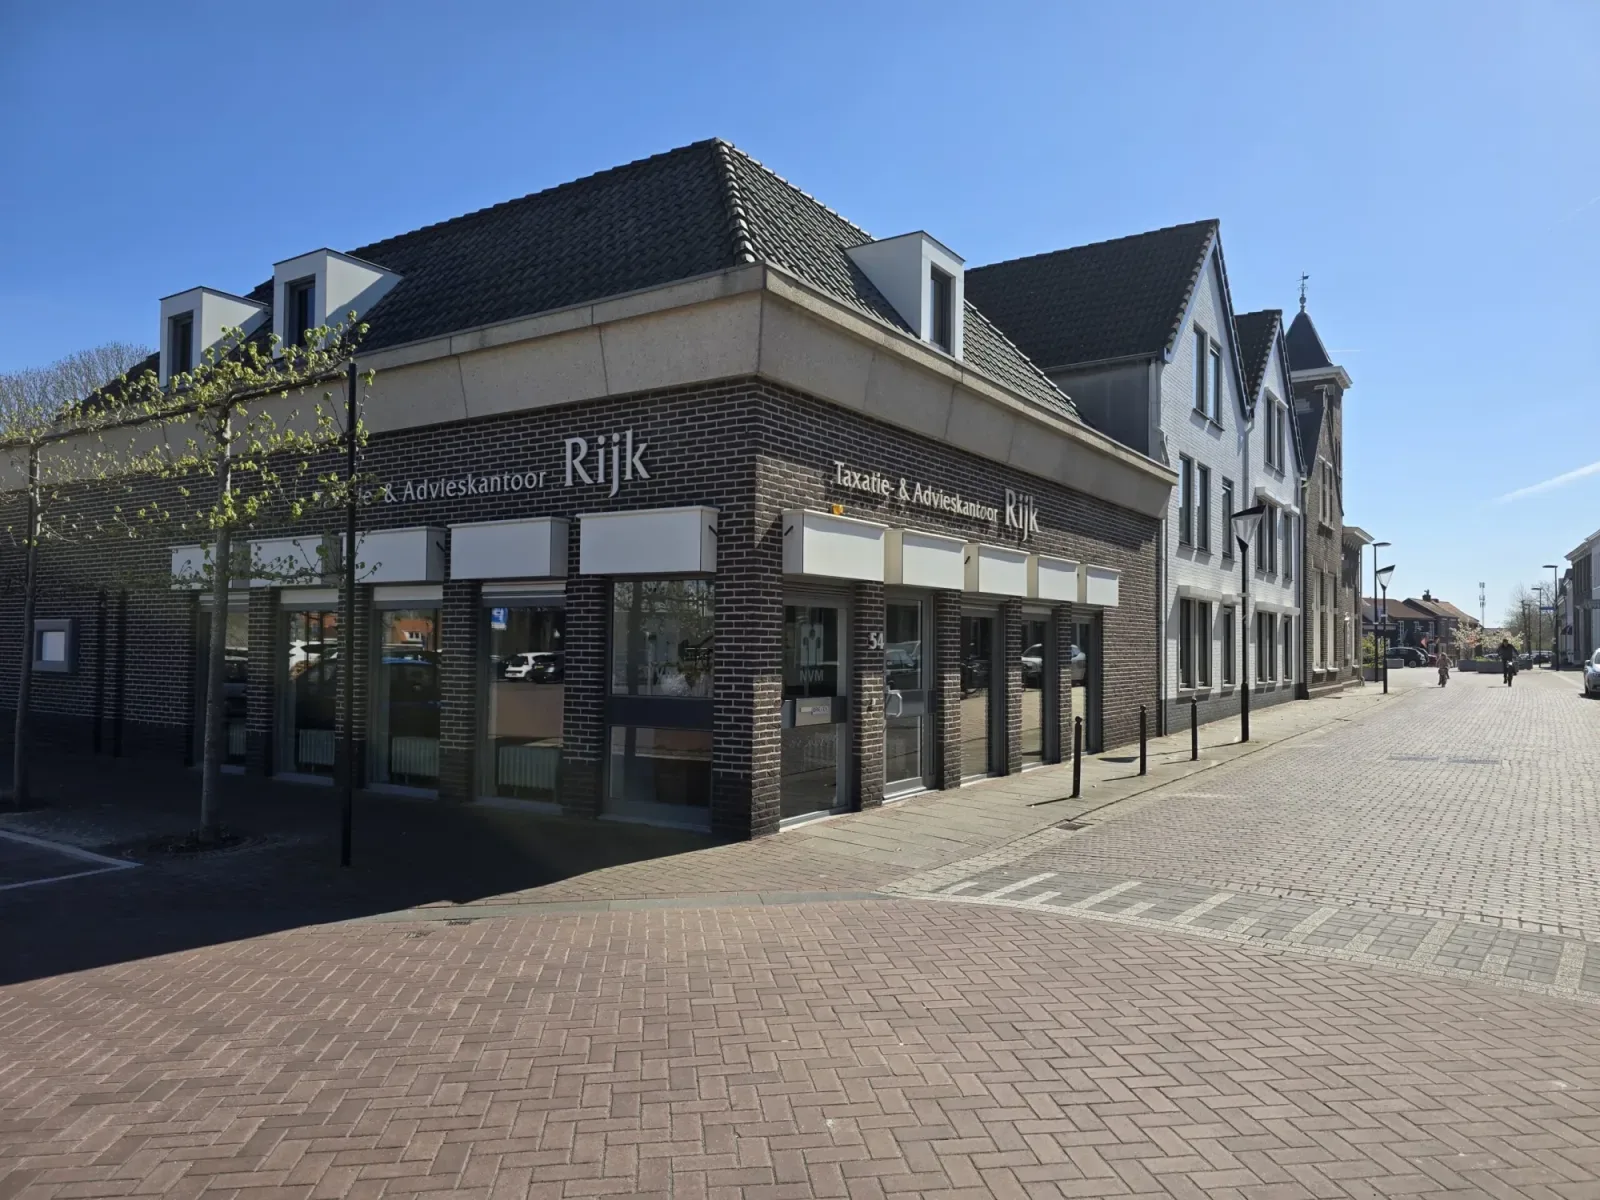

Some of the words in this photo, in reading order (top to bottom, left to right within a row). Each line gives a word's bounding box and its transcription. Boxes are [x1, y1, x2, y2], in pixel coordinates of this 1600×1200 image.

[384, 482, 398, 503] &
[403, 471, 546, 501] Advieskantoor
[563, 429, 650, 498] Rijk
[834, 461, 895, 496] Taxatie-
[899, 477, 910, 501] &
[912, 482, 998, 522] Advieskantoor
[1004, 488, 1039, 542] Rijk
[868, 632, 884, 649] 54
[800, 669, 824, 682] NVM
